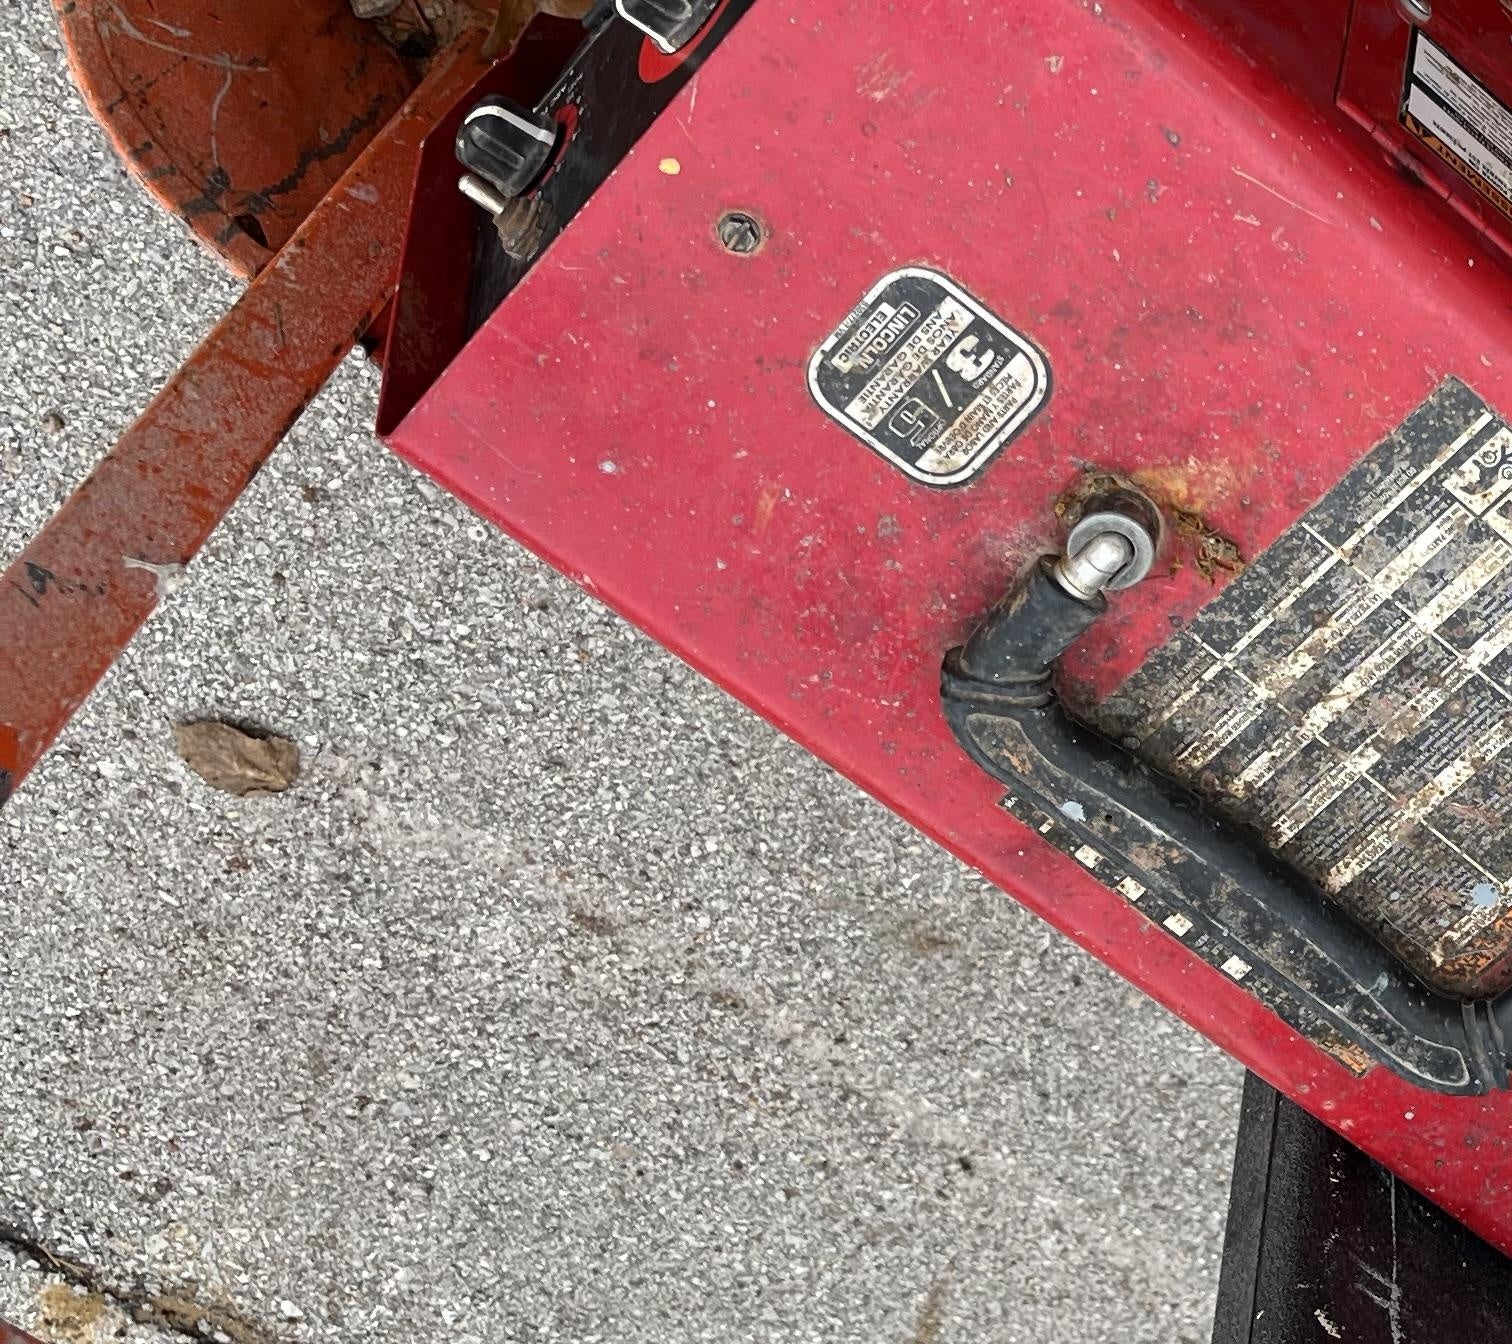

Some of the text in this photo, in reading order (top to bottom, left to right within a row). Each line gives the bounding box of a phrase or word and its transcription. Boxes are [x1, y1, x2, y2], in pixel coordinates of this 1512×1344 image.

[836, 309, 888, 364] ELECTRIC
[919, 310, 944, 336] ANS
[854, 305, 916, 370] LINCOLN
[905, 334, 922, 352] DE
[930, 327, 958, 357] YEAR
[910, 344, 927, 362] DE
[940, 329, 998, 387] 3
[970, 353, 1006, 392] STANDARD
[995, 395, 1018, 419] PARTS
[960, 431, 985, 456] LABOR
